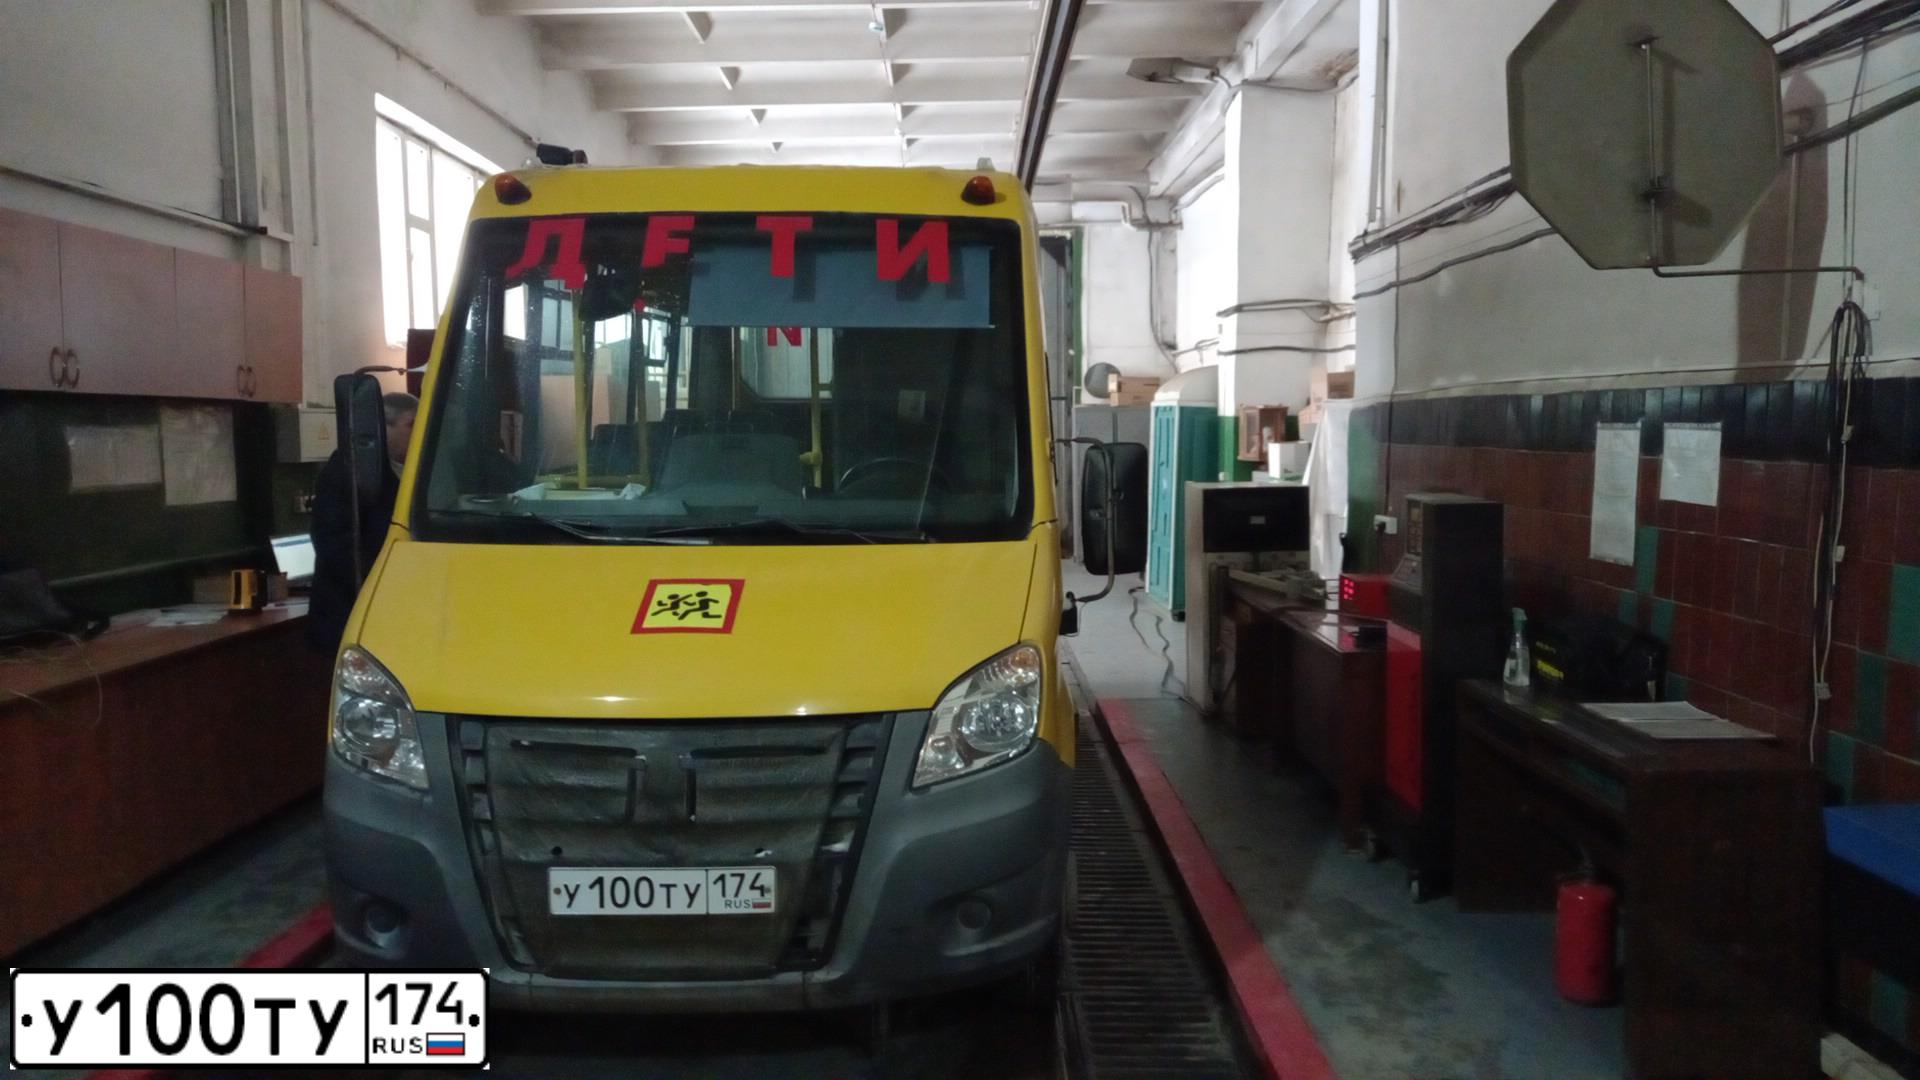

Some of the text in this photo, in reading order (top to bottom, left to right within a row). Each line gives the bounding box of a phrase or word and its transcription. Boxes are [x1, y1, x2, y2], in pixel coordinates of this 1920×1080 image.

[563, 873, 766, 908] У100ТУ 174
[724, 899, 751, 909] RUS
